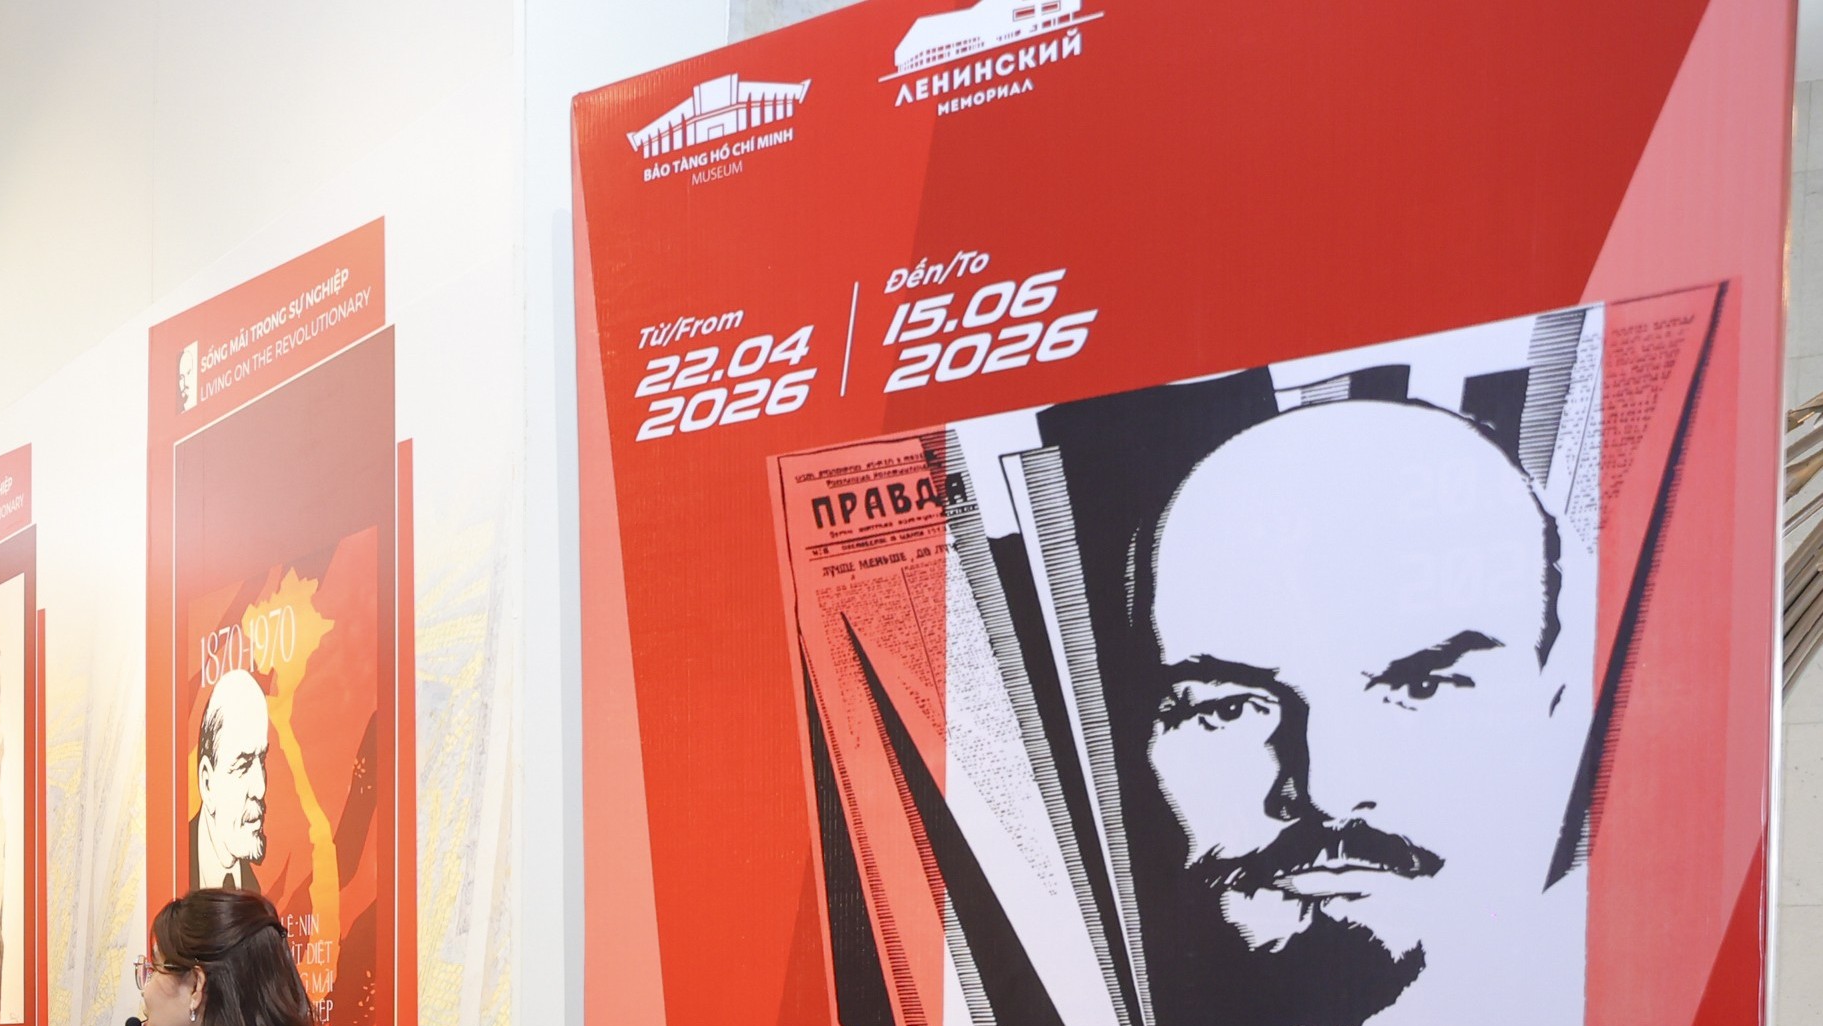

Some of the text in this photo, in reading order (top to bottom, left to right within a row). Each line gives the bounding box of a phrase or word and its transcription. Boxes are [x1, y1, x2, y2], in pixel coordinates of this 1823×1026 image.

[893, 28, 1082, 108] ЛЕНИНСКИЙ
[937, 79, 1033, 116] МЕМОРИАЛ
[644, 164, 670, 181] BẢO
[672, 153, 707, 173] TÀNG
[732, 137, 754, 156] CHÍ
[757, 128, 793, 149] MINH
[692, 161, 743, 185] MUSEUM
[882, 268, 1066, 346] 15.06
[885, 249, 989, 294] Đến/To
[200, 286, 372, 402] LIVING ON THE REVOLUTIONARY
[201, 268, 349, 373] SỐNG MÃI TRONG SỰ NGHIỆP
[638, 307, 744, 350] Từ/From
[883, 309, 1098, 393] 2026
[634, 325, 813, 399] 22.04
[635, 368, 816, 441] 2026
[811, 472, 968, 529] ПРАВДА
[201, 605, 295, 688] 1870-1970
